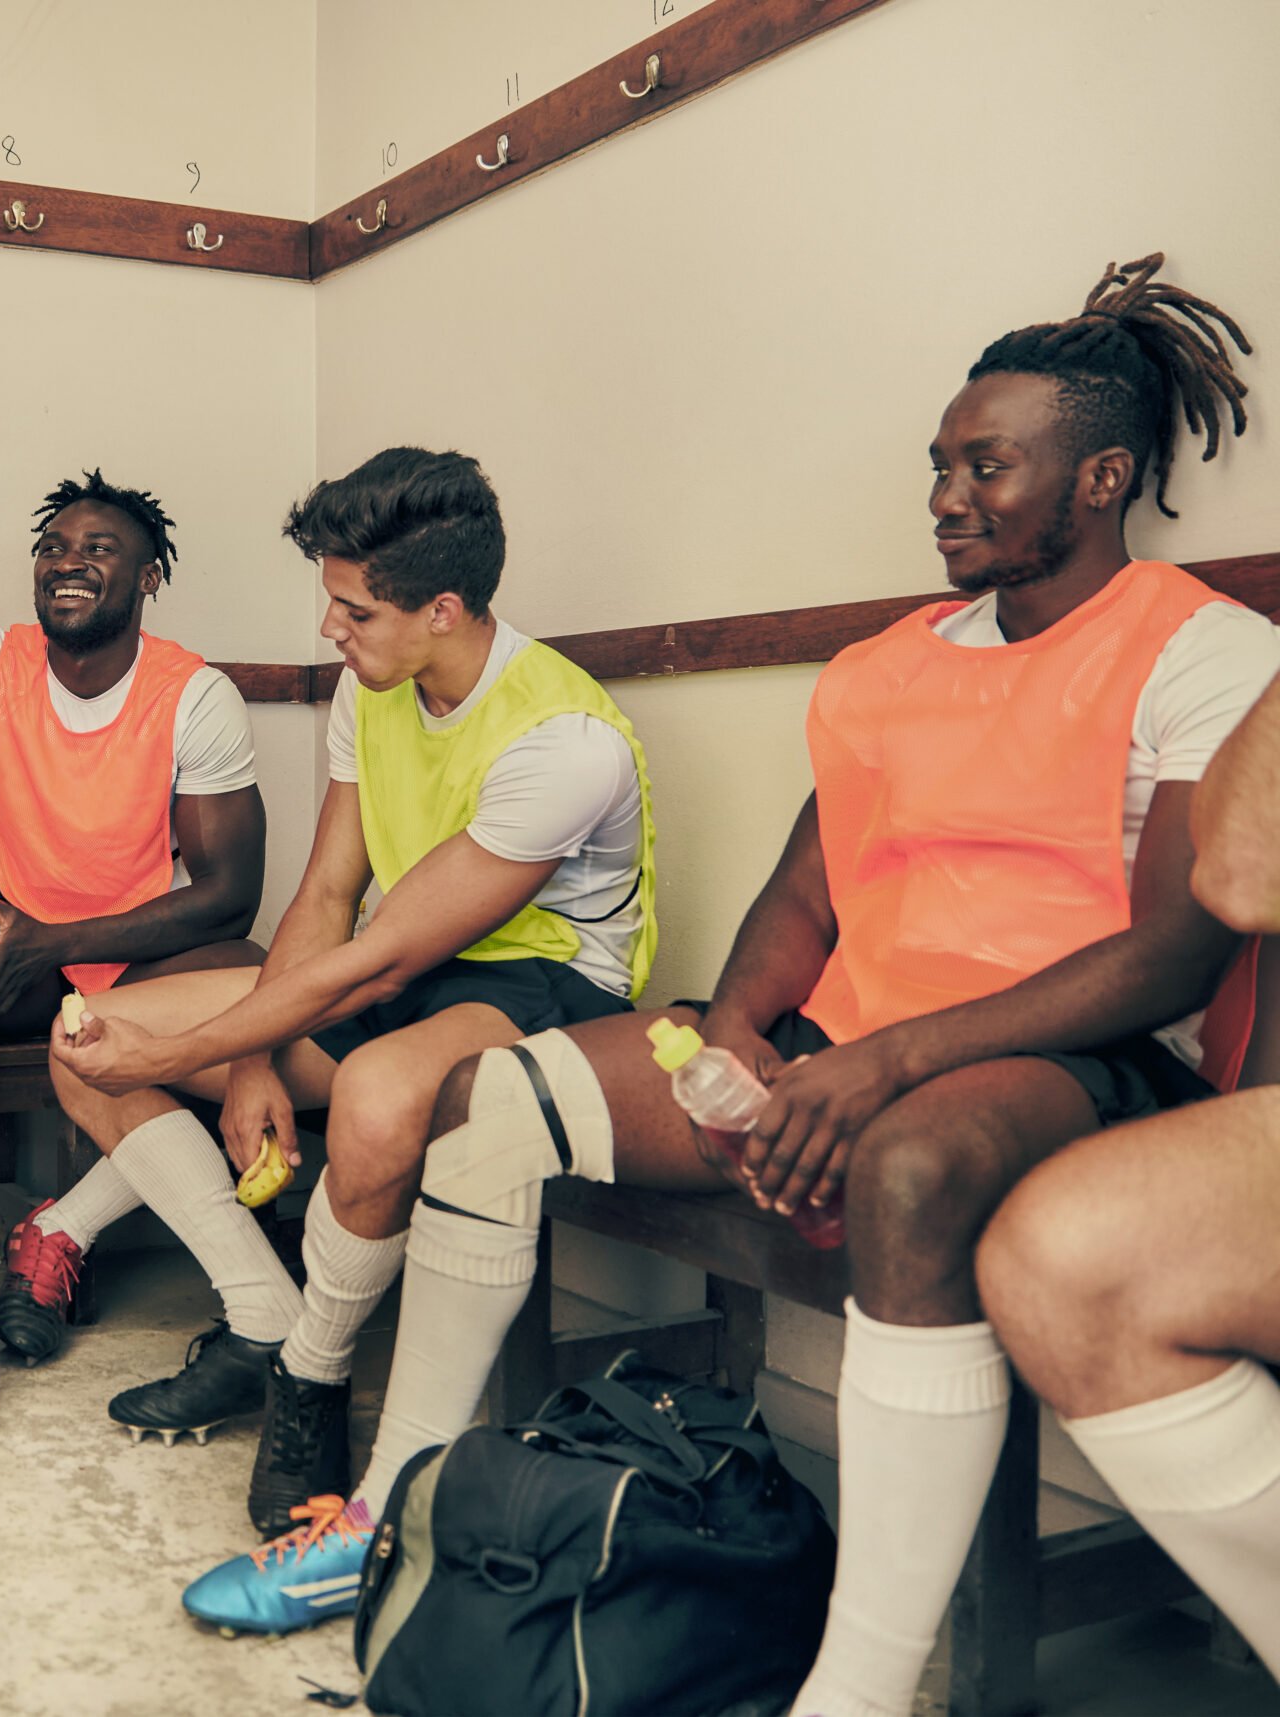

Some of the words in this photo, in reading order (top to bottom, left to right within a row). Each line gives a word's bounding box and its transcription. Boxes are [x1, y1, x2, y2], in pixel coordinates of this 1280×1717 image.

[506, 72, 521, 107] 11
[1, 134, 22, 167] 8
[382, 141, 399, 176] 10
[185, 161, 201, 195] 9
